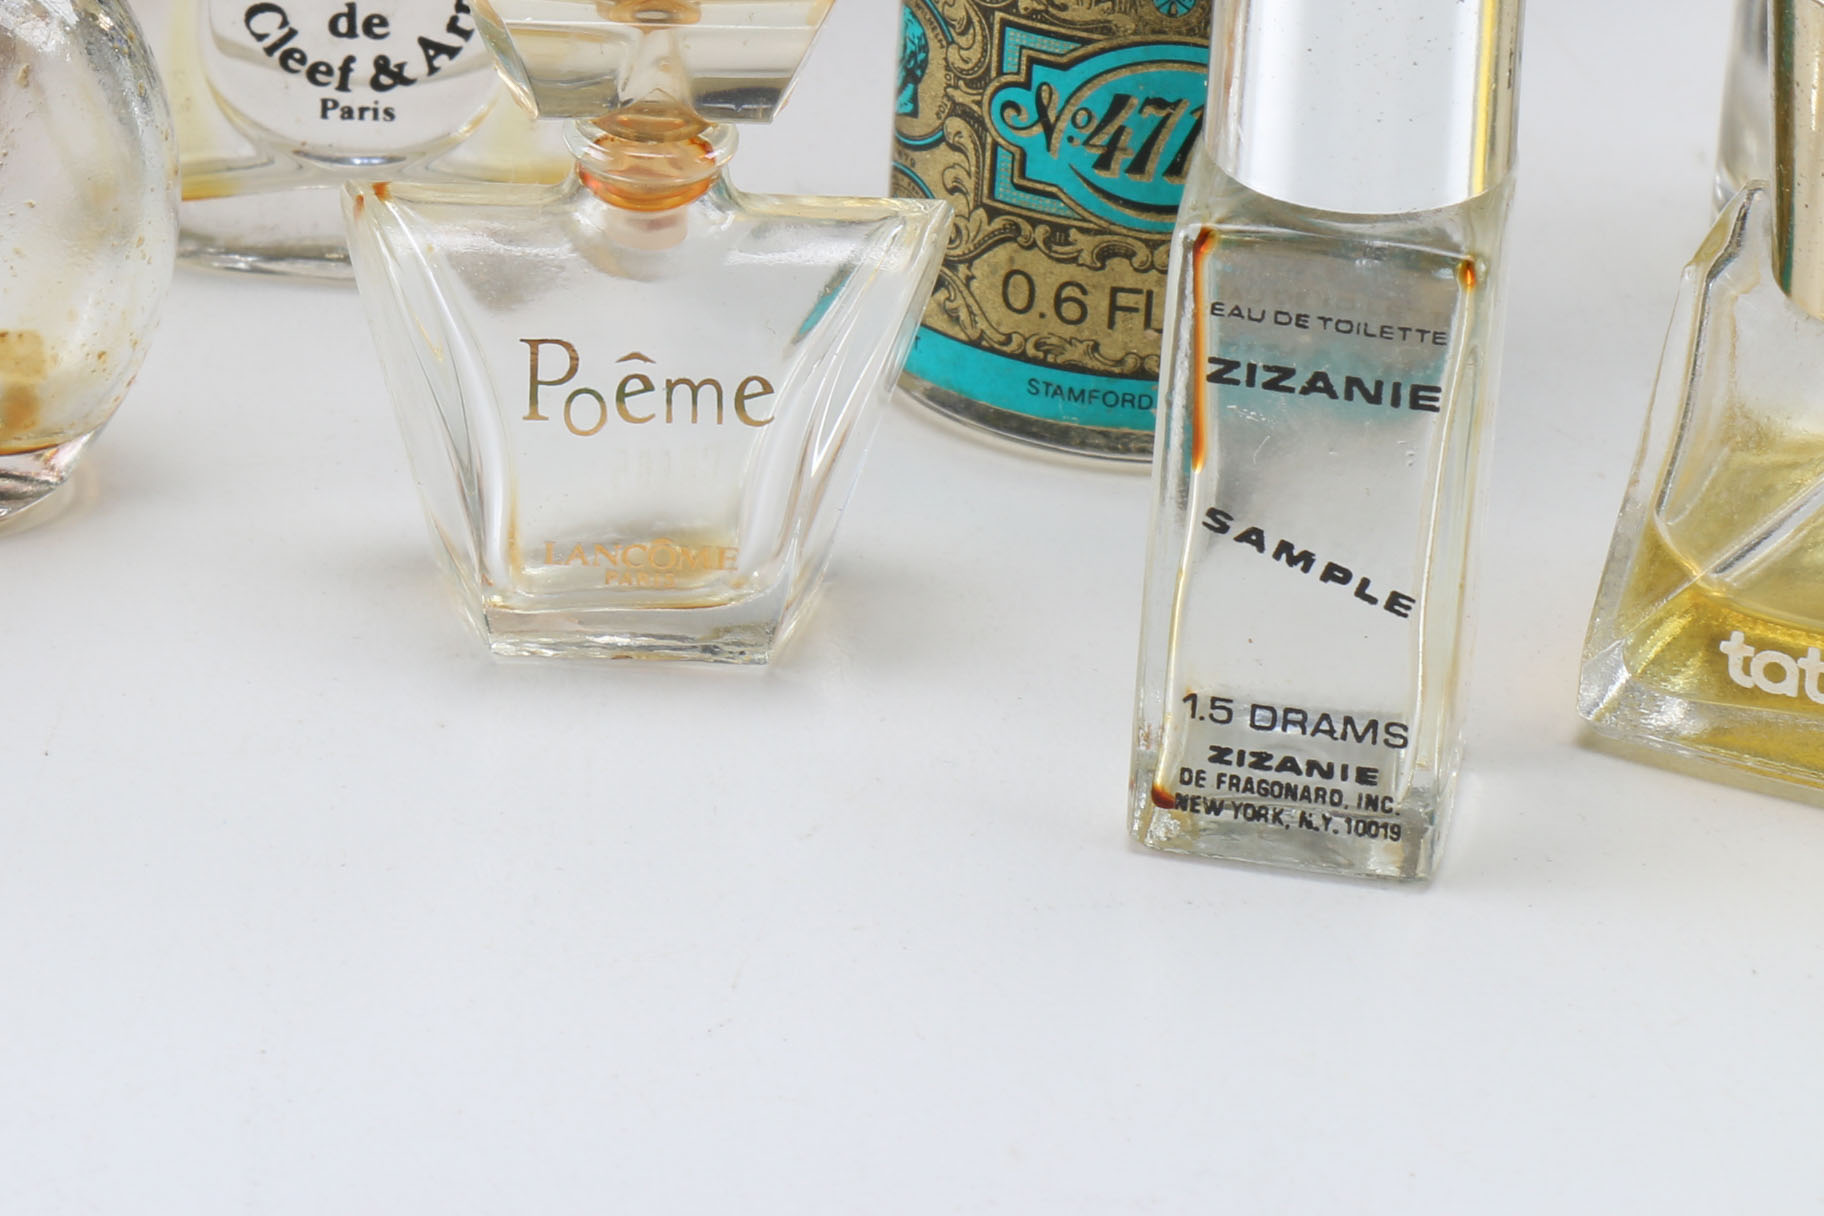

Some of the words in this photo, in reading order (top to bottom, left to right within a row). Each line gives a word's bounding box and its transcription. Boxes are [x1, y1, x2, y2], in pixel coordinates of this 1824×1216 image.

[327, 1, 392, 40] de
[243, 0, 356, 93] Cleef
[368, 54, 418, 93] &
[319, 97, 398, 123] Paris
[1000, 268, 1090, 327] 0.6
[1209, 301, 1267, 324] EAU
[1272, 309, 1311, 330] DE
[1316, 315, 1449, 347] TOILETTE
[518, 336, 777, 438] Poême
[1026, 378, 1155, 412] STAMFORD
[1205, 355, 1444, 414] ZIZANIE
[542, 536, 741, 572] LANCÔME
[1200, 506, 1418, 620] SAMPLE
[1182, 692, 1235, 725] 1.5
[1248, 702, 1411, 750] DRAMS
[1207, 744, 1380, 787] ZIZANIE
[1175, 791, 1226, 818] NEW
[1230, 800, 1291, 831] YORK,
[1343, 815, 1403, 843] 10019
[1178, 766, 1208, 789] DE
[1356, 792, 1401, 817] INC.
